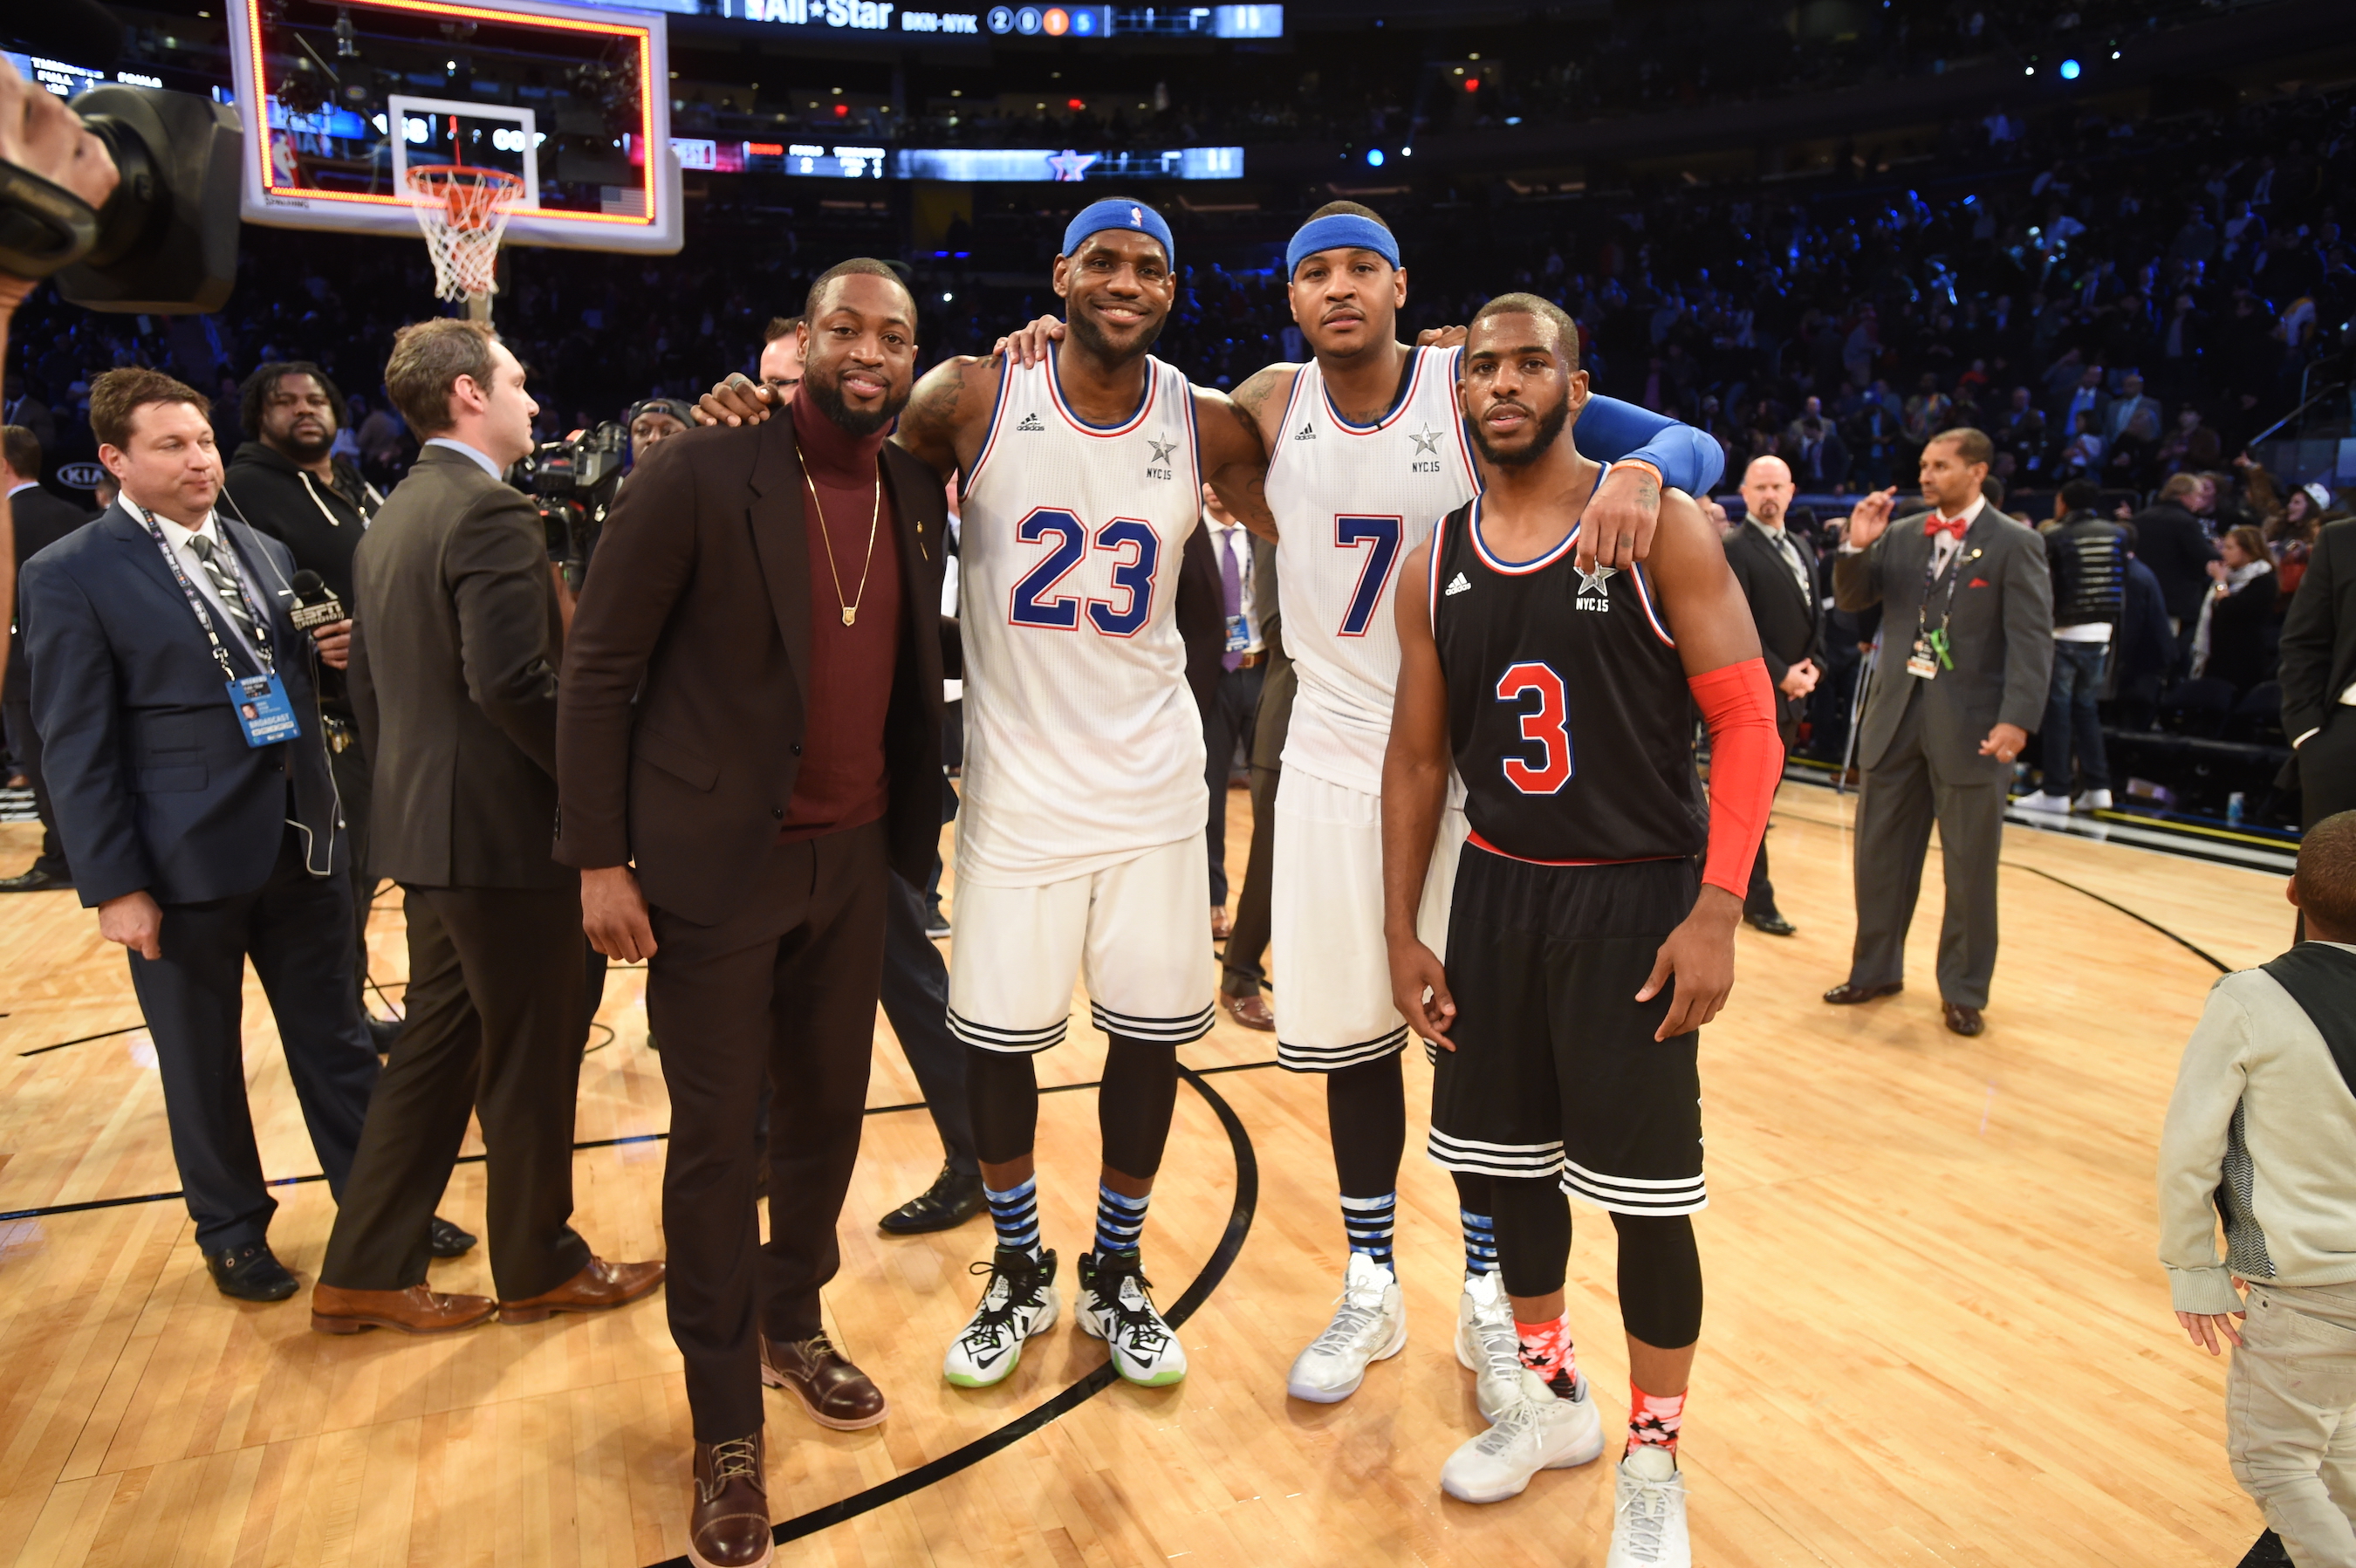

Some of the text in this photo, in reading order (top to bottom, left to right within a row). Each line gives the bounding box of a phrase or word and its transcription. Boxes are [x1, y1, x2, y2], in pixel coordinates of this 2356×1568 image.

[1146, 468, 1172, 480] NYC 15
[1412, 462, 1440, 473] NYC 15
[67, 468, 104, 483] KIA
[1008, 506, 1161, 638] 23
[1334, 514, 1403, 637] 7
[1445, 582, 1471, 596] adidas
[291, 600, 342, 622] ESPN
[1576, 598, 1609, 613] NYC 15
[1495, 659, 1576, 797] 3
